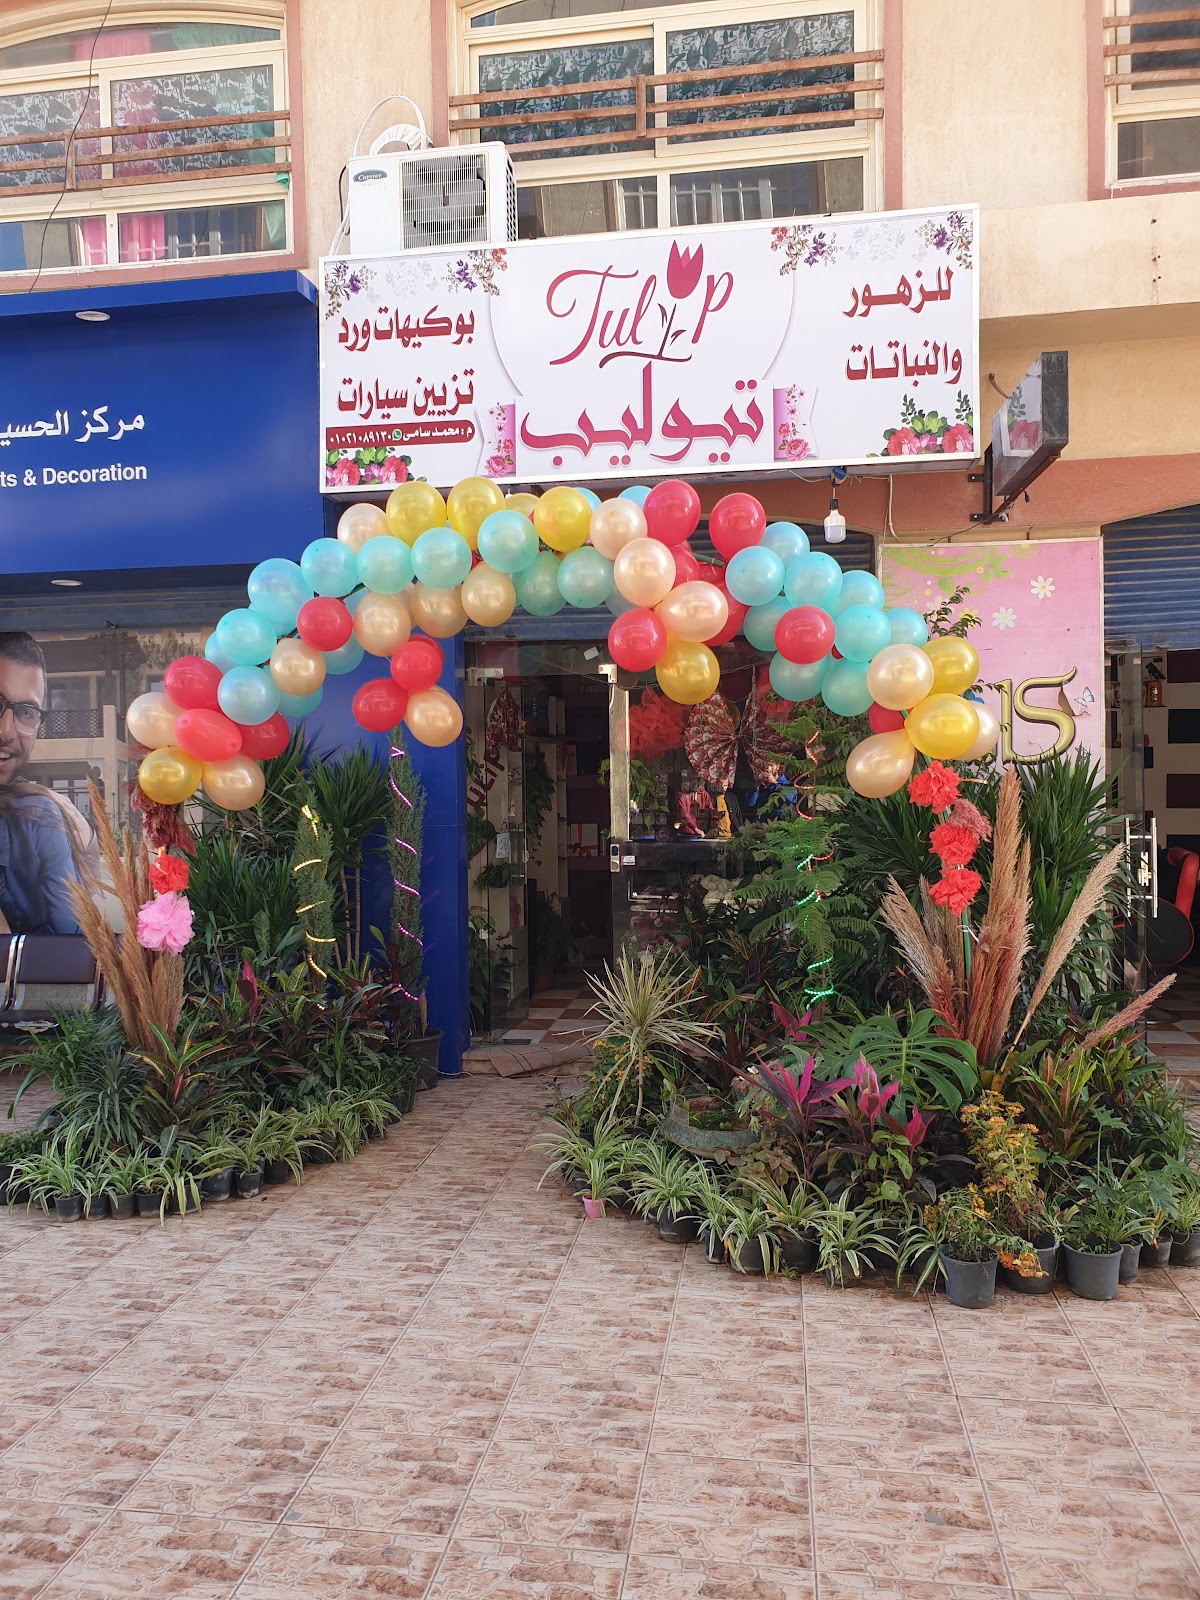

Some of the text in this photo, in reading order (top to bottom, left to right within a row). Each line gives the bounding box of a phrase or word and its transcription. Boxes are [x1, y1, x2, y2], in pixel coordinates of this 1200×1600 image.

[357, 172, 383, 181] Carrier
[841, 264, 954, 318] للزهور
[338, 304, 475, 352] بوكيهات ورد
[844, 339, 963, 388] والنباتات
[337, 368, 475, 420] تزيين سيارات
[520, 360, 765, 467] تيوليب
[0, 405, 146, 447] مركز الحسي
[431, 425, 460, 437] محمد
[0, 463, 148, 488] ts & Decoration
